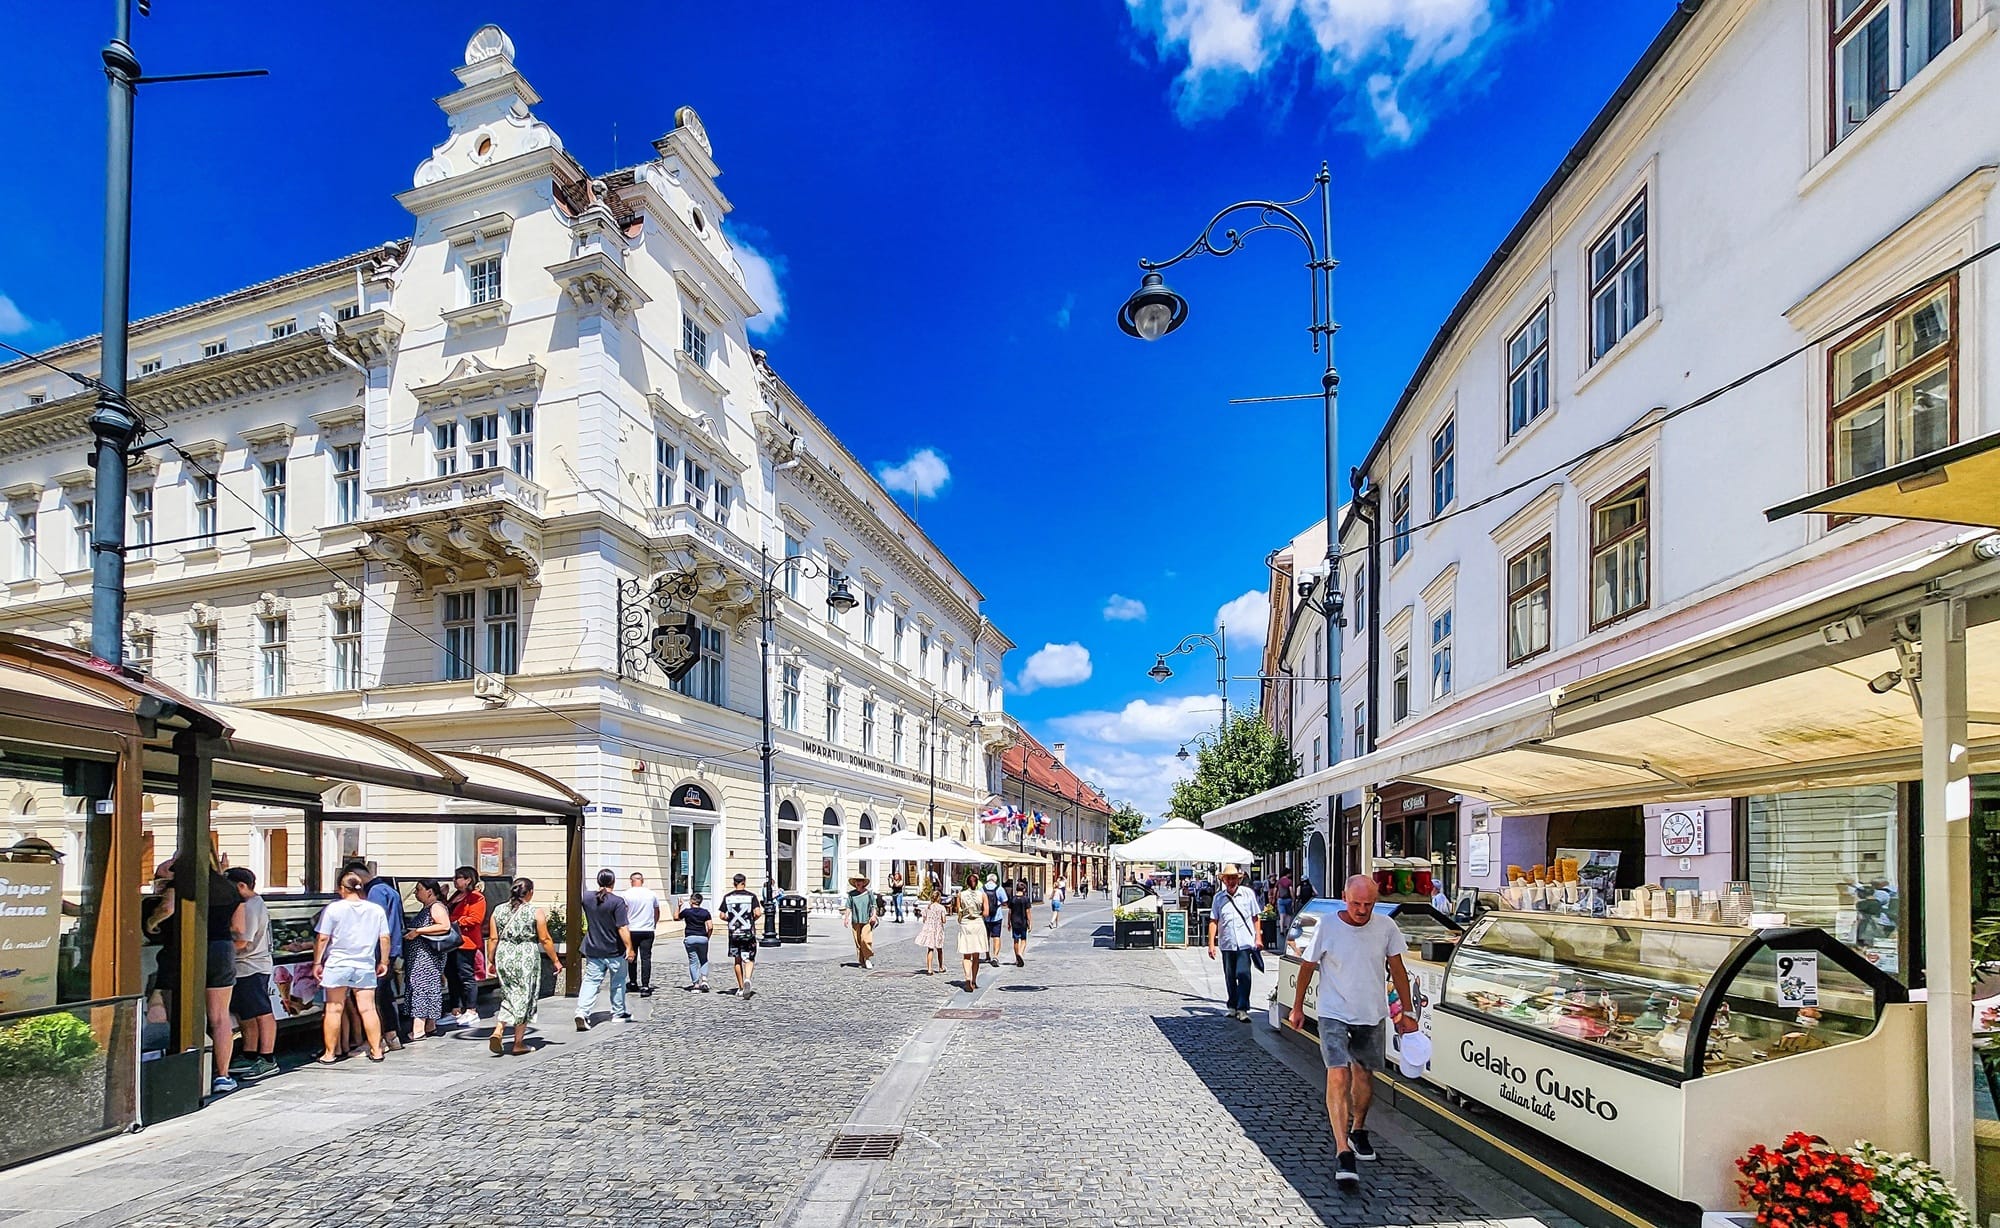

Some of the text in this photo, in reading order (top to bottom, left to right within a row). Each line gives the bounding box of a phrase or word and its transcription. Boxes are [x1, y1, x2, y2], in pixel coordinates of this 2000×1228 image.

[802, 740, 845, 763] IMPARATUL
[849, 754, 885, 773] ROMANILOR
[891, 767, 906, 780] HOTEL
[0, 877, 51, 899] Super
[2, 938, 13, 951] la
[1779, 957, 1794, 977] 9
[1460, 1039, 1618, 1121] Gelato Gusto
[1500, 1082, 1557, 1122] italian taste
